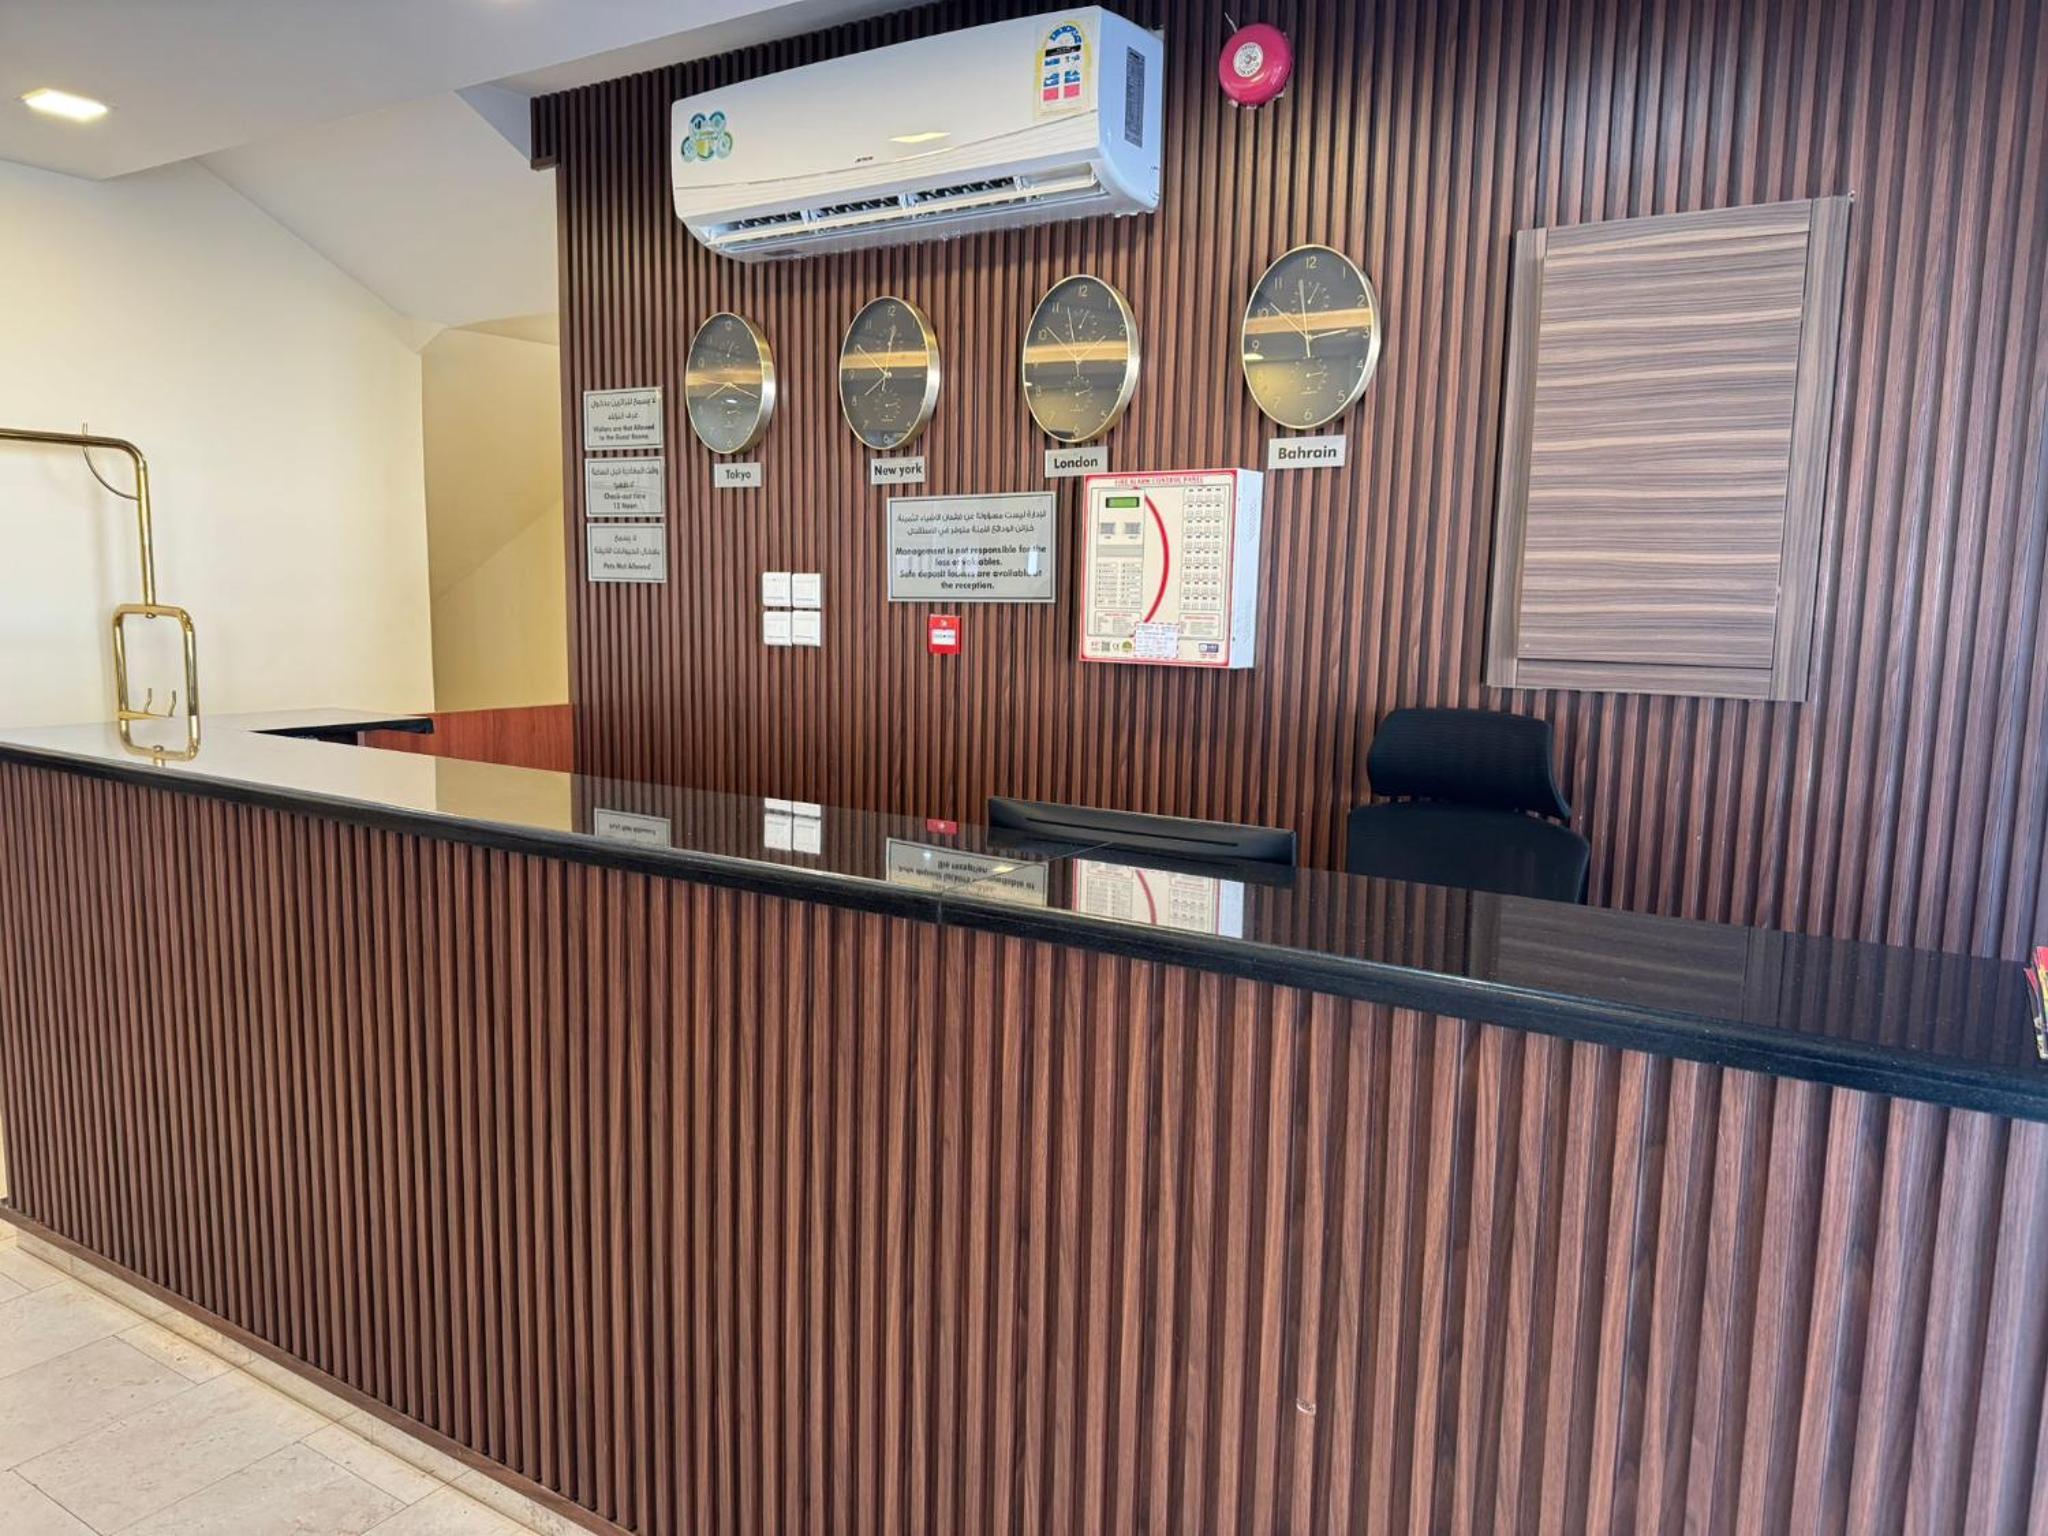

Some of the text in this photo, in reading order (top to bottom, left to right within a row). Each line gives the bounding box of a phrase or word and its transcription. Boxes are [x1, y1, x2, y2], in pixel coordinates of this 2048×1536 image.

[1306, 256, 1317, 269] 12
[1078, 285, 1088, 297] 12
[1357, 294, 1366, 307] 2
[1252, 340, 1260, 352] 9
[1304, 409, 1312, 421] 6
[1277, 446, 1338, 461] Bahrain
[1053, 456, 1099, 470] London
[725, 469, 752, 481] Tokyo
[874, 462, 923, 478] New york
[895, 547, 945, 557] Management
[970, 545, 1017, 555] responsible
[918, 569, 946, 579] deposit
[993, 568, 1033, 577] availabl
[941, 581, 995, 590] the reception.
